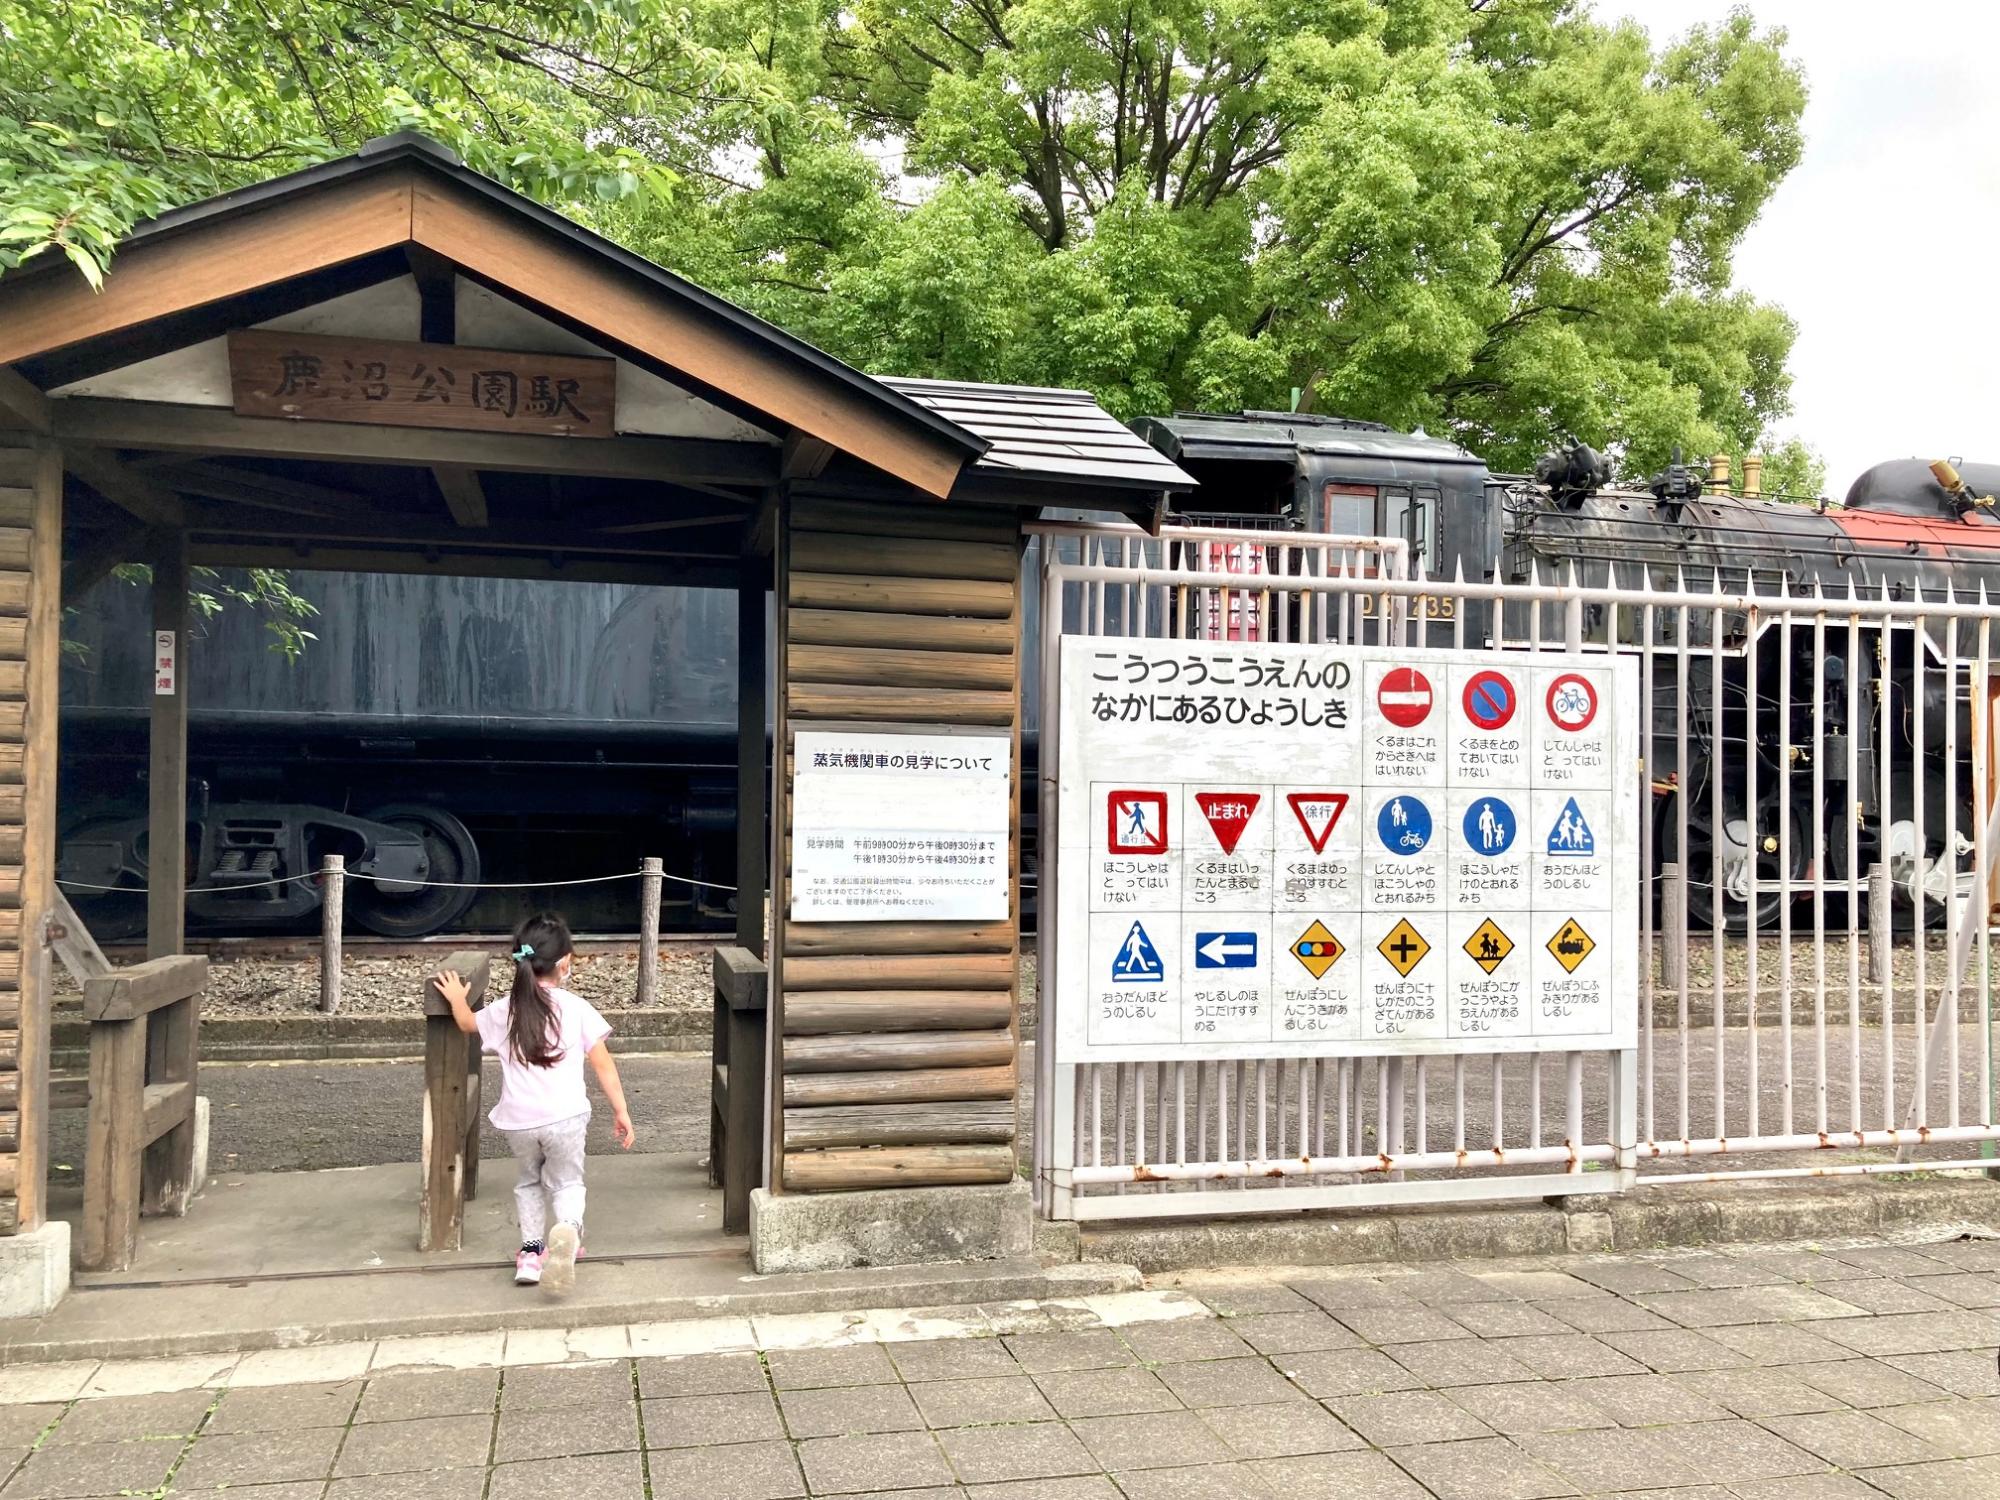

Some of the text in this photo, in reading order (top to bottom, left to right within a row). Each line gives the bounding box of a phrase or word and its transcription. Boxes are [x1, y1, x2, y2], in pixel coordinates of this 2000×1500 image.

[272, 351, 590, 423] 鹿沼公園駅
[158, 657, 172, 688] 禁煙
[1092, 652, 1351, 690] こうつうこうえんの
[1092, 692, 1348, 728] なかにあるひょうしき
[1375, 737, 1437, 748] くるまはこれ
[1459, 739, 1519, 750] くるまをとめ
[1543, 740, 1602, 752] じてんしゃは
[1375, 750, 1436, 762] からさきへは
[1459, 753, 1519, 764] ておいてはい
[813, 753, 992, 771] 蒸気機関車の見学について
[1375, 765, 1426, 777] はいれない
[1459, 767, 1490, 777] けない
[1543, 769, 1573, 780] けない
[1208, 804, 1249, 819] 止まれ
[1305, 804, 1331, 819] 徐行
[806, 840, 995, 851] 見学時間 午前9時00分から午後0時30分まで
[854, 855, 995, 865] 午後1時30分から午後4時30分まで
[1104, 862, 1168, 874] ほこうしゃは
[1195, 863, 1260, 874] くるまはいっ
[1287, 863, 1347, 874] くるまはゆっ
[1374, 864, 1435, 875] じてんしゃと
[1459, 864, 1519, 875] ほこうしゃだ
[1543, 864, 1601, 875] おうだんほど
[1374, 879, 1435, 889] ほこうしゃの
[1459, 879, 1519, 889] けのとおれる
[1543, 879, 1591, 889] うのしるし
[1104, 892, 1136, 903] けない
[1195, 892, 1216, 904] ころ
[1374, 893, 1435, 904] とおれるみち
[1459, 893, 1481, 904] みち
[1102, 992, 1168, 1003] おうだんほど
[1194, 990, 1259, 1002] やじるしのほ
[1460, 994, 1519, 1006] っこうやよう
[1541, 993, 1600, 1005] みきりがある
[1374, 996, 1435, 1008] じがたのこう
[1194, 1005, 1259, 1017] うにだけすす
[1374, 1009, 1435, 1020] ざてんがある
[1460, 1007, 1519, 1019] ちえんがある
[1542, 1005, 1572, 1017] しるし
[1194, 1021, 1216, 1032] める
[1284, 1018, 1328, 1031] るしるし
[1374, 1023, 1406, 1033] しるし
[1460, 1021, 1490, 1032] しるし
